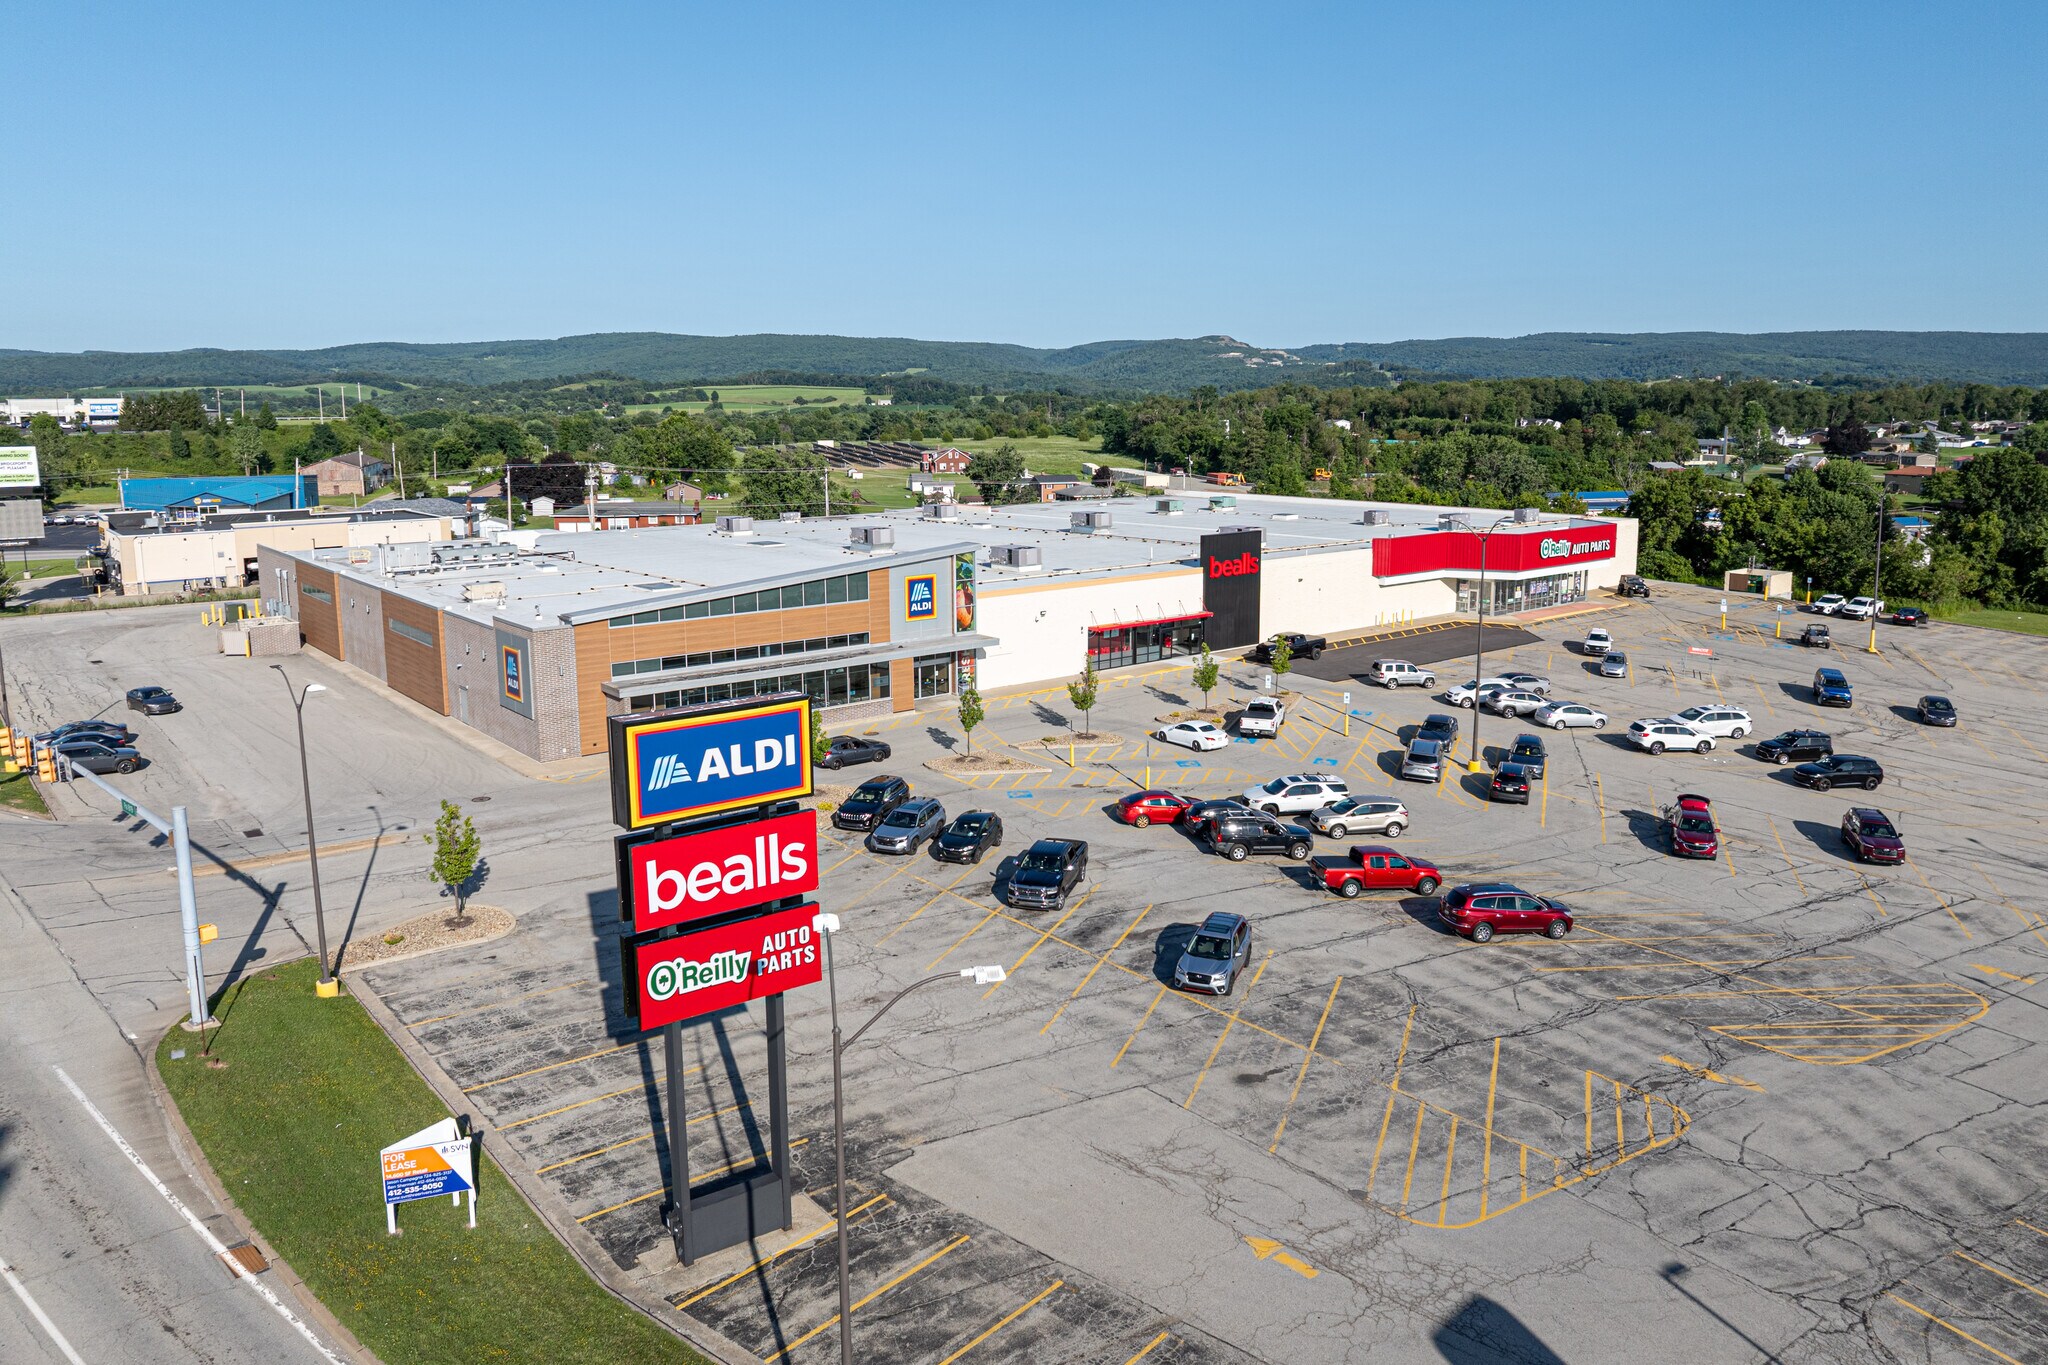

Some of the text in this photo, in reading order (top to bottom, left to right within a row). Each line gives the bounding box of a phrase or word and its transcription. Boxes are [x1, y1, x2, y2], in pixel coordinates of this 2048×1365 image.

[1541, 538, 1610, 558] O'Reilly AUTO PARTS
[1209, 552, 1259, 579] bealls
[911, 602, 932, 611] ALDI
[508, 677, 519, 690] ALDI
[697, 734, 796, 784] ALDI
[645, 833, 807, 914] bealls
[762, 925, 810, 955] AUTO
[757, 945, 815, 976] PARTS
[648, 951, 751, 1000] O'Reilly
[384, 1152, 405, 1164] FOR
[451, 1144, 468, 1153] SVN
[385, 1160, 417, 1172] LEASE
[388, 1182, 443, 1196] 412-535-8050
